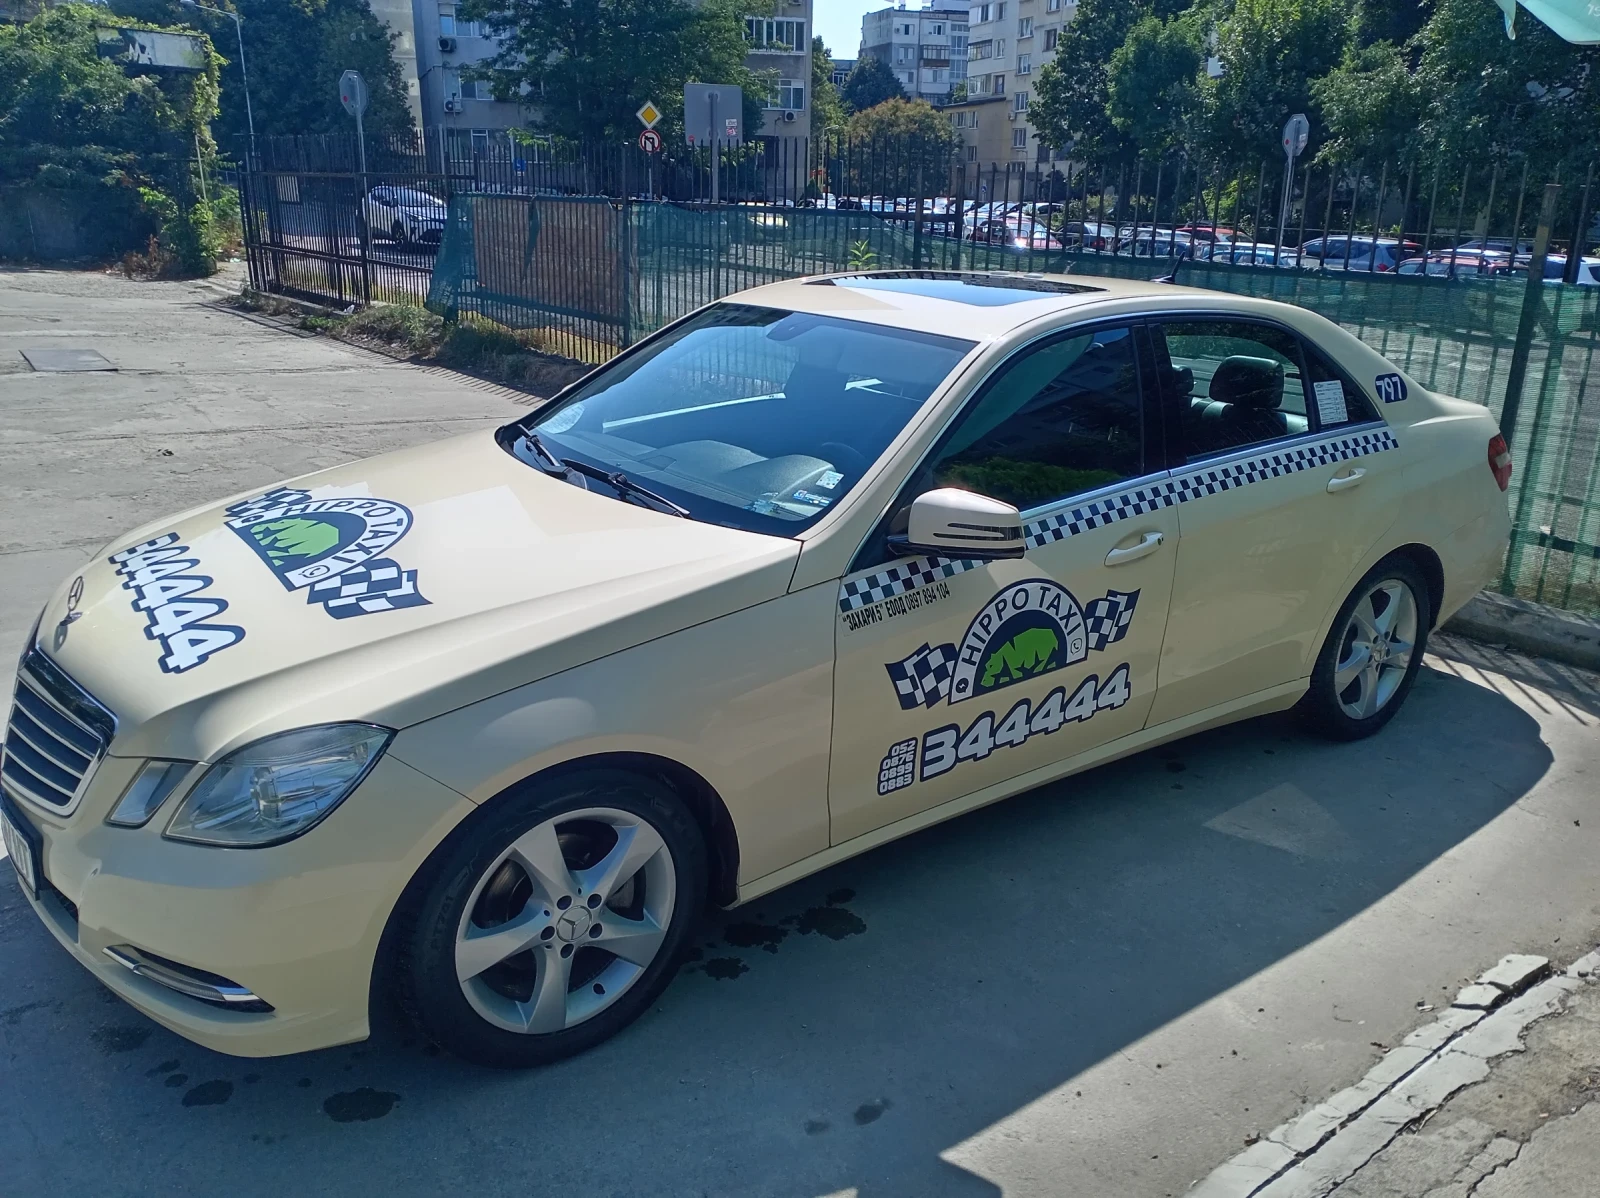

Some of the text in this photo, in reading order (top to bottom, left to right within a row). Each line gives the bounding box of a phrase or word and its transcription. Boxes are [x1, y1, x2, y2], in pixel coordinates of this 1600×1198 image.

[1375, 376, 1403, 404] 797
[281, 500, 404, 565] HIPPO TAXI
[110, 533, 242, 672] 344444
[884, 597, 908, 617] ЕООД
[905, 591, 923, 611] 0897
[922, 586, 938, 605] 894
[936, 581, 951, 600] 104
[961, 585, 1082, 667] HIPPO TAXI
[921, 665, 1130, 780] 344444
[882, 751, 914, 770] 0876
[891, 740, 916, 757] 052
[879, 773, 912, 793] 0883
[880, 762, 913, 781] 0899
